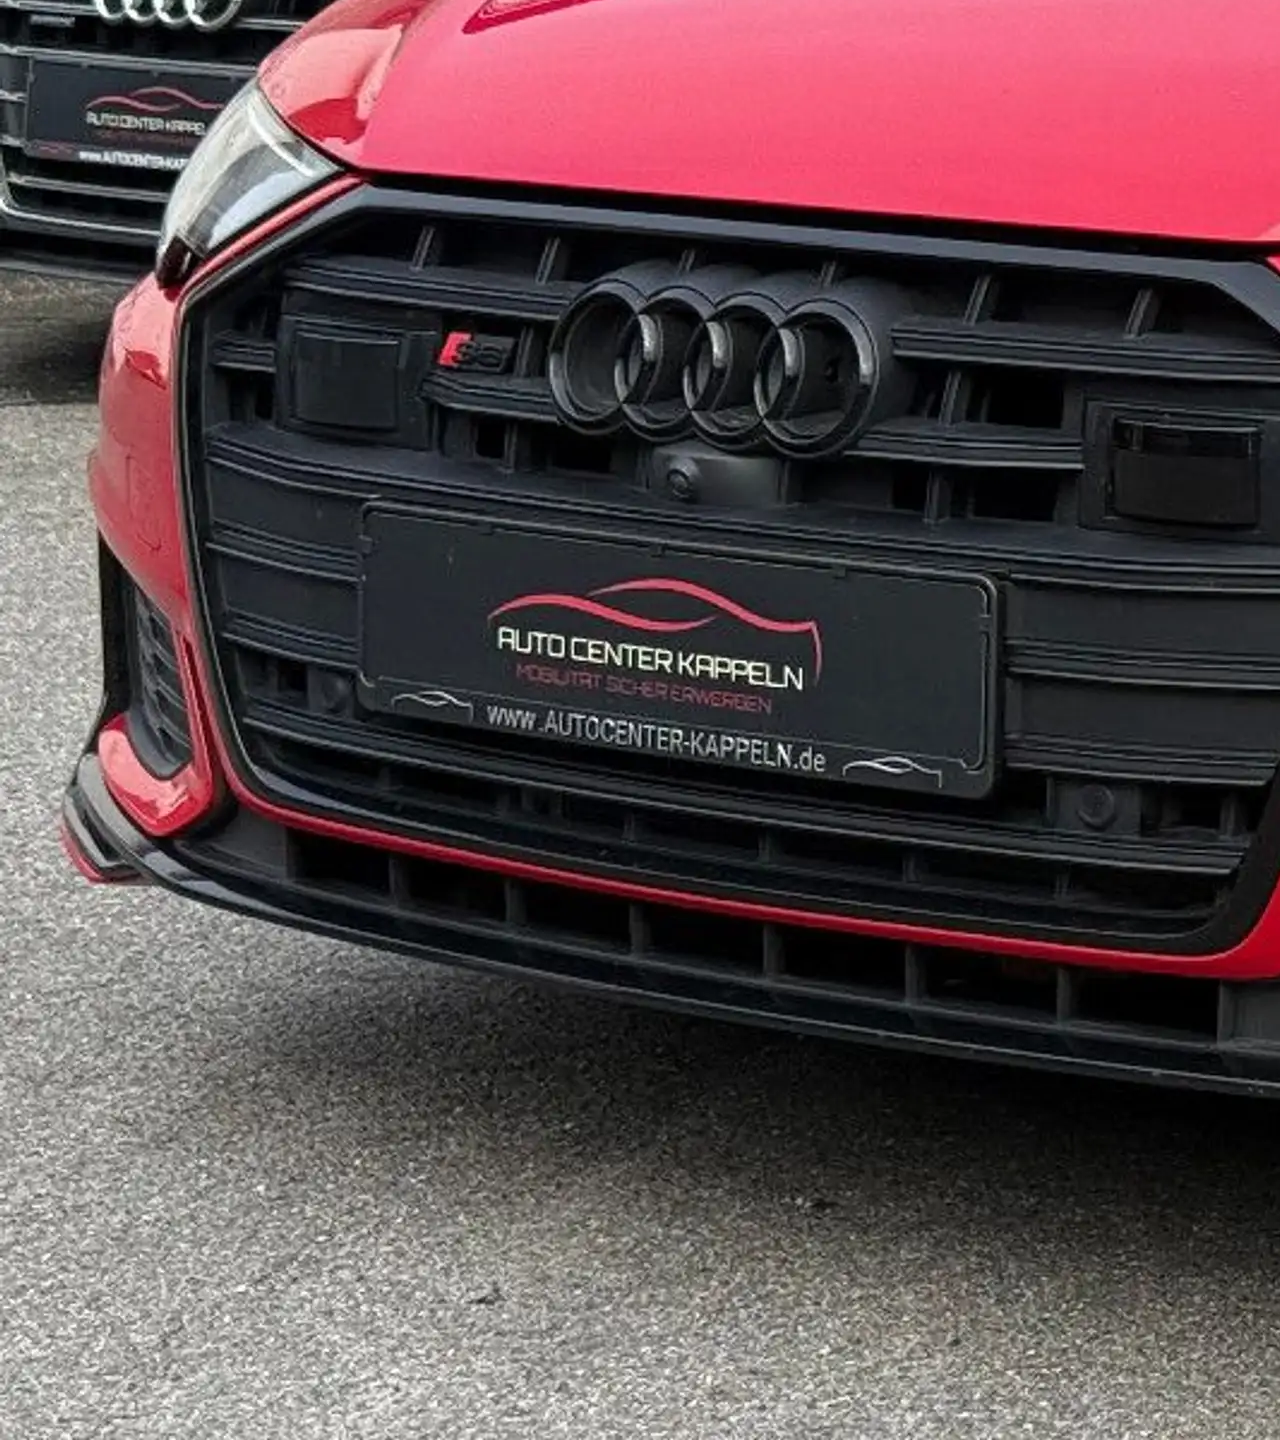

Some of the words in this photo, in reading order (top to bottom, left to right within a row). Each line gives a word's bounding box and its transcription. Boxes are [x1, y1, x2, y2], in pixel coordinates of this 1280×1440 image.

[497, 626, 565, 658] AUTO
[571, 637, 673, 673] CENTER
[677, 652, 803, 691] KAPPELN
[605, 677, 667, 698] SICHER
[669, 688, 773, 715] ERWERBEN
[487, 705, 826, 773] www.AUTOCENTER-KAPPELN.de
